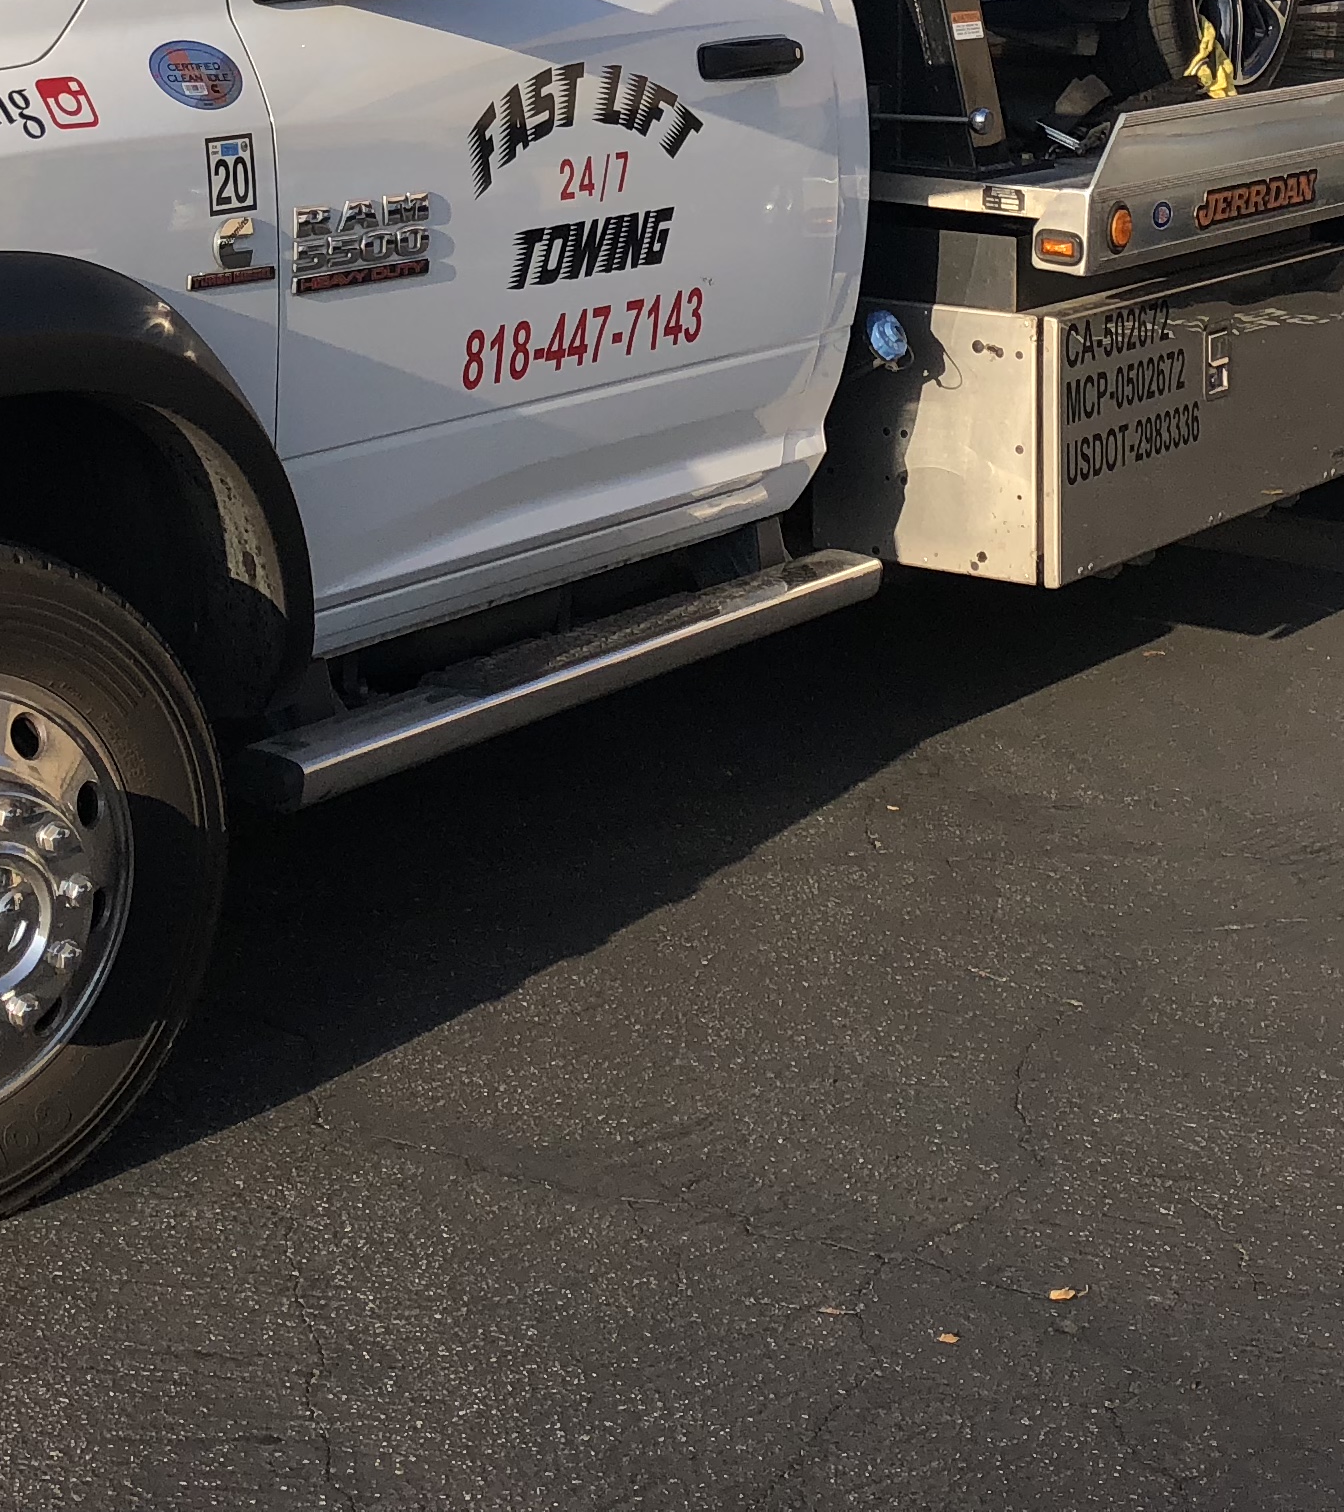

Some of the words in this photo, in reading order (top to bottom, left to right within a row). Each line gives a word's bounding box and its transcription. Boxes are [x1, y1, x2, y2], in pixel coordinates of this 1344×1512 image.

[167, 61, 221, 72] CERTIFIED
[167, 73, 203, 83] CLEAN
[467, 62, 584, 200] FAST
[592, 64, 704, 159] LIFT
[214, 155, 249, 207] 20
[559, 151, 629, 202] 24/7
[1195, 170, 1318, 230] JERR-DAN
[293, 192, 429, 238] RAM
[292, 225, 429, 273] 5500
[300, 271, 369, 291] HEAVY
[370, 260, 426, 281] DUTY
[506, 206, 675, 290] TOWING
[462, 287, 703, 391] 818-447-7143
[1065, 300, 1170, 368] CA-502672
[1065, 348, 1185, 426] MCP-0502672
[1065, 400, 1200, 486] USDOT-2983336
